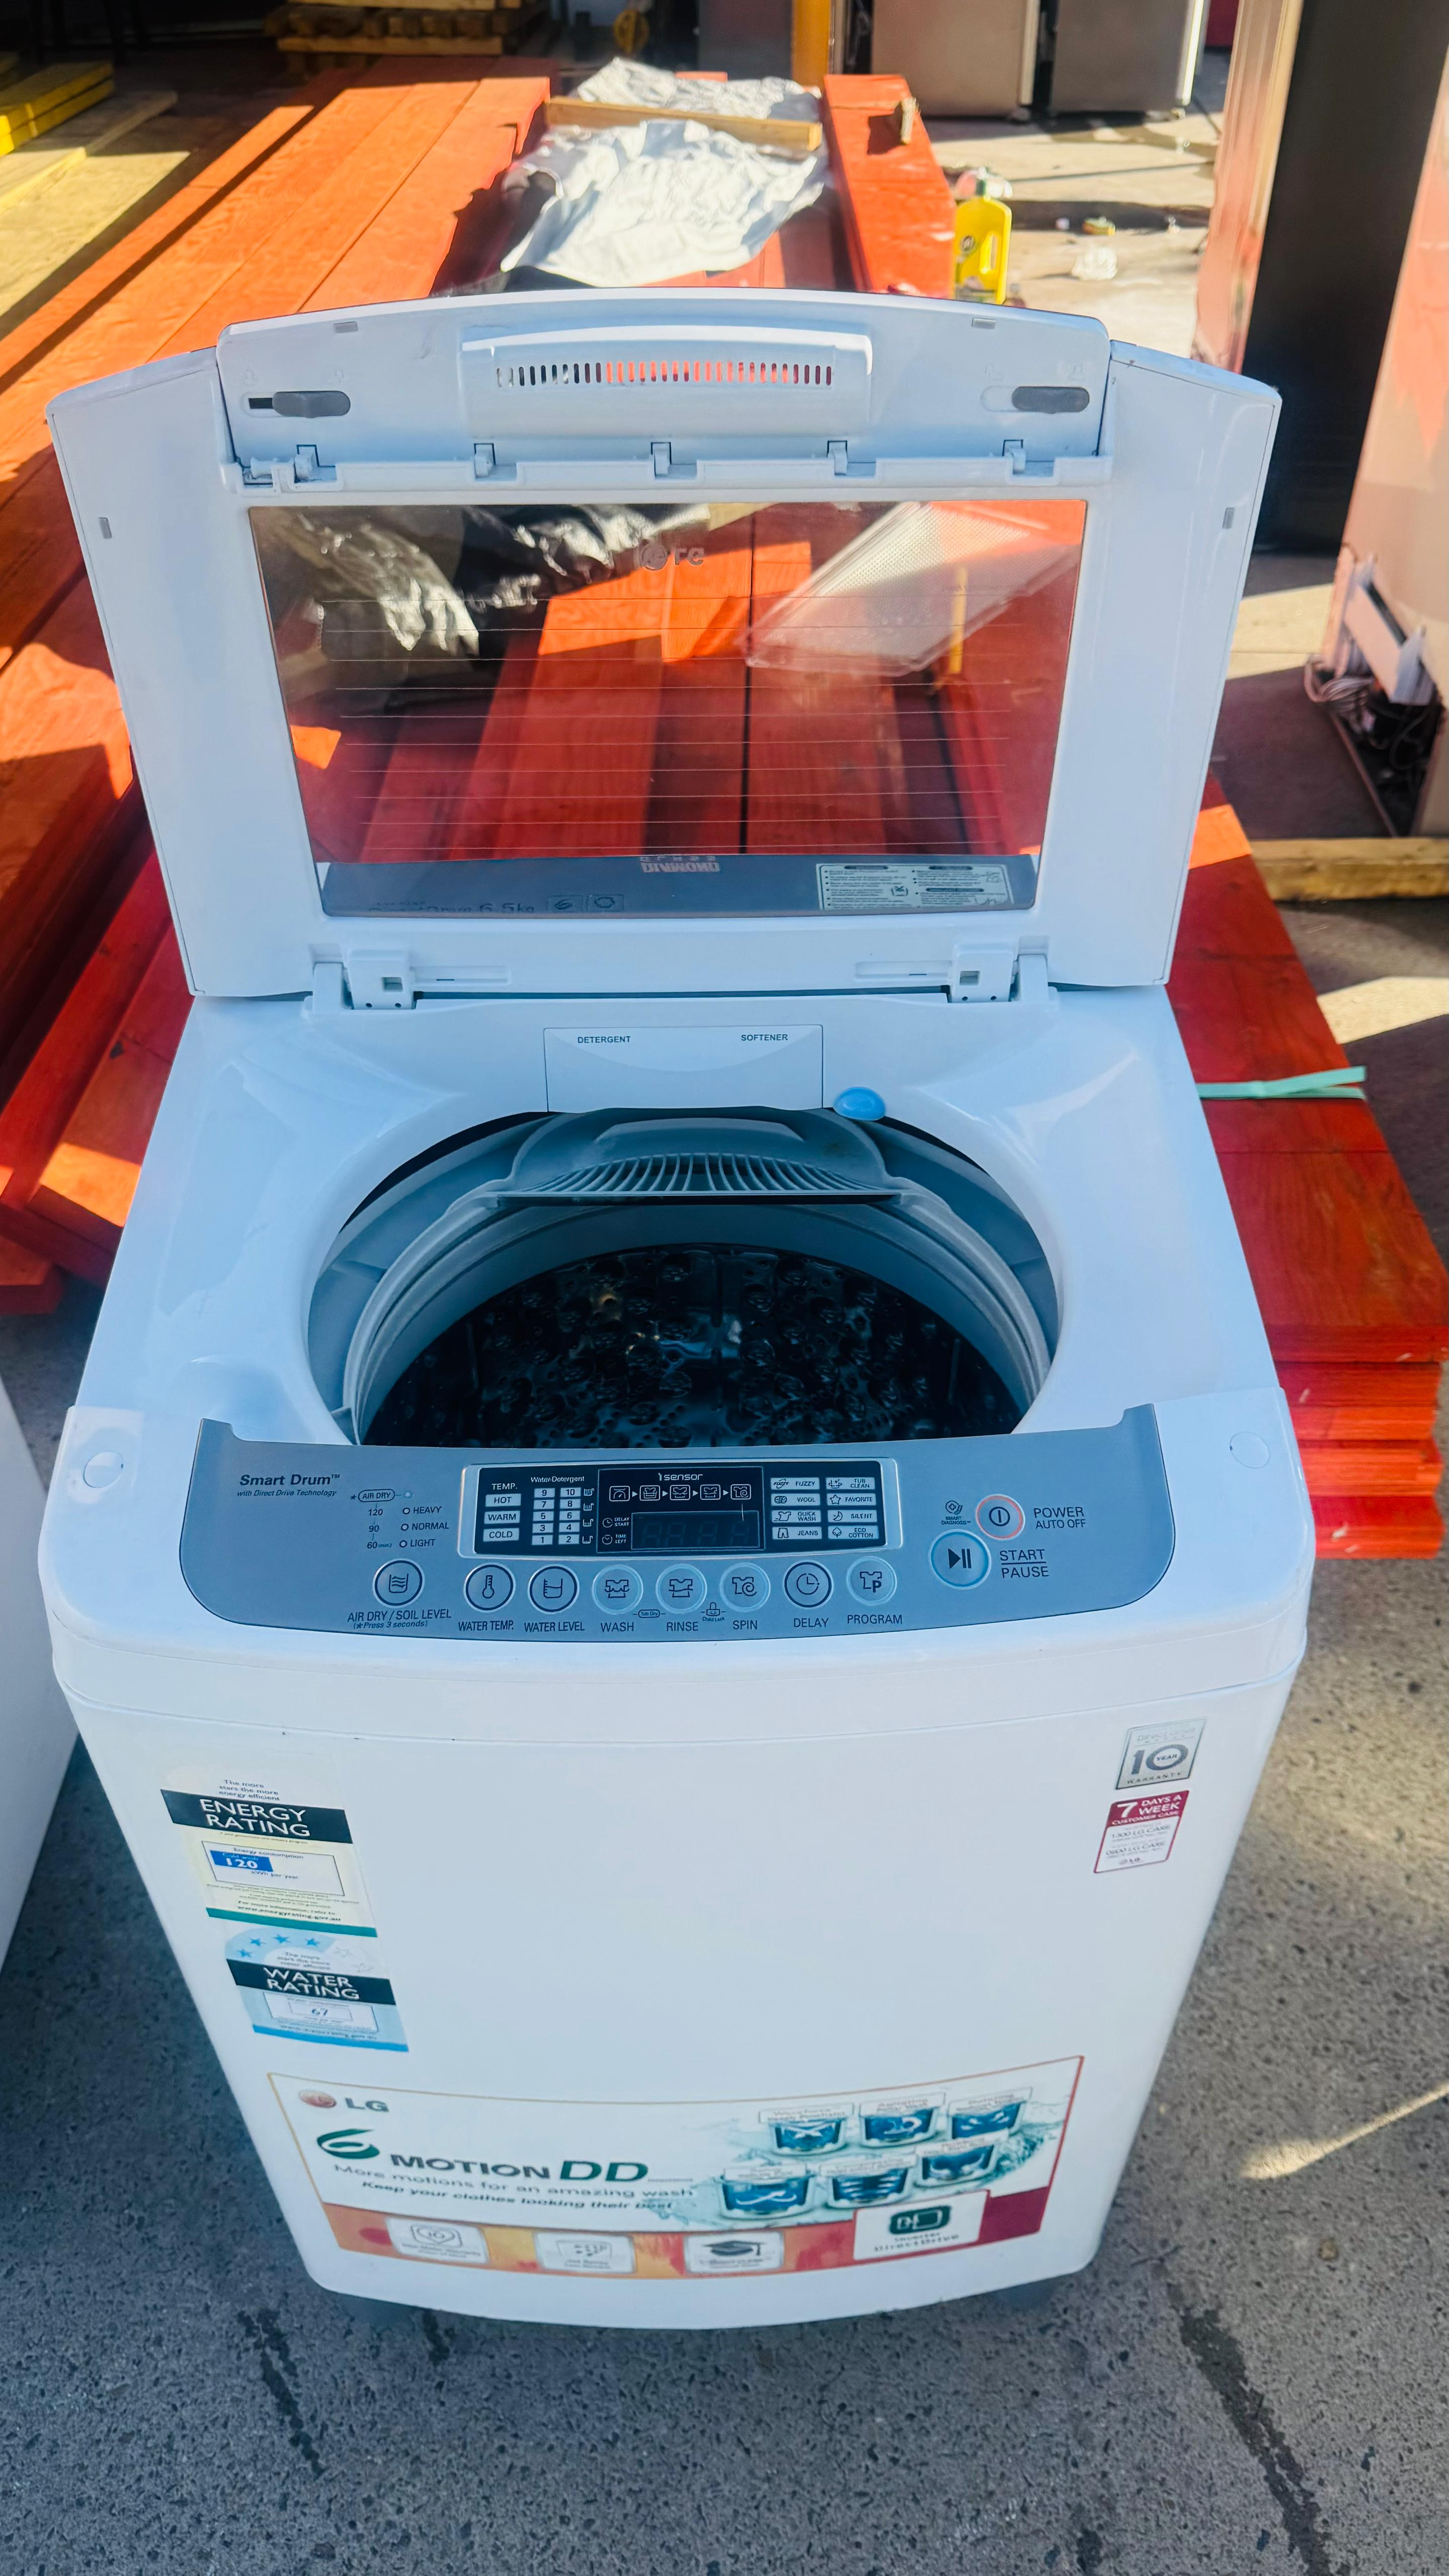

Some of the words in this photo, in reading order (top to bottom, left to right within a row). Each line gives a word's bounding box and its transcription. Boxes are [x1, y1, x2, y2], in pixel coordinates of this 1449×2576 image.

[240, 1474, 285, 1485] Smart
[1034, 1507, 1085, 1518] POWER
[412, 1522, 449, 1530] NORMAL
[1035, 1519, 1065, 1529] AUTO
[1067, 1518, 1086, 1528] OFF
[1000, 1549, 1045, 1561] START
[1001, 1566, 1050, 1578] PAUSE
[347, 1612, 364, 1622] AIR
[367, 1611, 388, 1621] DRY
[396, 1610, 419, 1620] SOIL
[422, 1609, 451, 1619] LEVEL
[847, 1615, 903, 1624] PROGRAM
[458, 1621, 488, 1631] WATER
[490, 1620, 514, 1630] TEMP.
[524, 1622, 555, 1632] WATER
[558, 1621, 585, 1631] LEVEL
[601, 1622, 634, 1632] WASH
[667, 1621, 699, 1631] RINSE
[733, 1620, 758, 1630] SPIN
[794, 1618, 829, 1628] DELAY
[219, 1790, 246, 1798] energy
[200, 1799, 306, 1822] ENERGY
[1117, 1802, 1138, 1818] 7
[1141, 1796, 1171, 1807] DAYS
[1139, 1802, 1179, 1815] WEEK
[206, 1814, 310, 1836] RATING
[259, 1851, 304, 1859] consumption
[226, 1858, 258, 1869] 120
[263, 1967, 353, 1987] WATER
[267, 1978, 360, 1999] RATING
[345, 2098, 389, 2112] LG
[390, 2154, 550, 2180] MOTION
[560, 2160, 648, 2182] DD
[334, 2165, 385, 2178] More
[392, 2175, 474, 2188] motions
[481, 2181, 508, 2190] for
[547, 2187, 635, 2197] amazing
[642, 2187, 694, 2197] wash
[362, 2181, 404, 2193] Keep
[410, 2188, 448, 2198] your
[453, 2194, 515, 2203] clothes
[522, 2197, 585, 2209] looking
[591, 2201, 630, 2209] their
